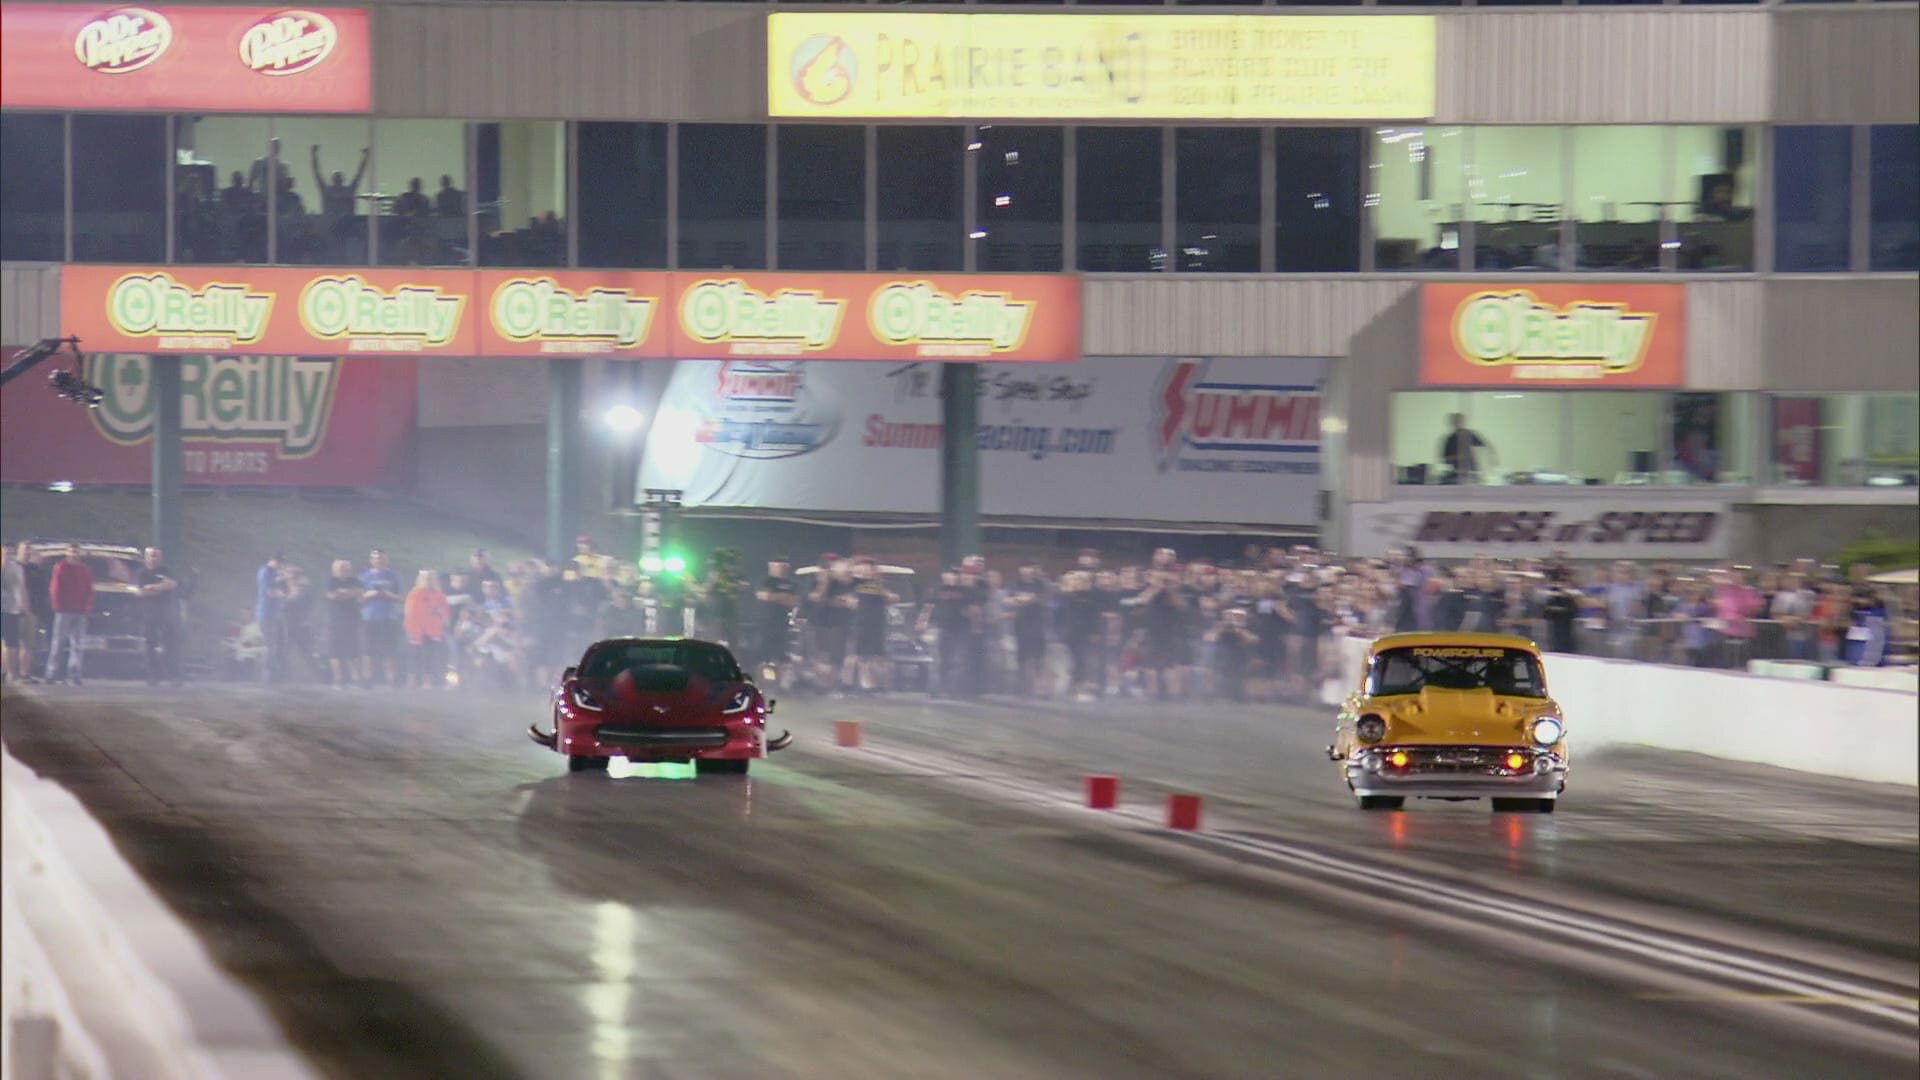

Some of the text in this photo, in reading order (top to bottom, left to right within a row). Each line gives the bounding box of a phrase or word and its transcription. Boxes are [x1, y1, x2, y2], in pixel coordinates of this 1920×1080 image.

[876, 31, 1028, 101] PRAIRIE
[114, 279, 267, 340] O'Reilly
[306, 282, 459, 343] O'Reilly
[499, 282, 647, 343] O'Reilly
[690, 283, 838, 346] O'Reilly
[877, 284, 1027, 348] O'Reilly
[211, 451, 268, 474] PARTS
[1415, 511, 1557, 543] HOUSE
[1592, 511, 1722, 543] SPEED
